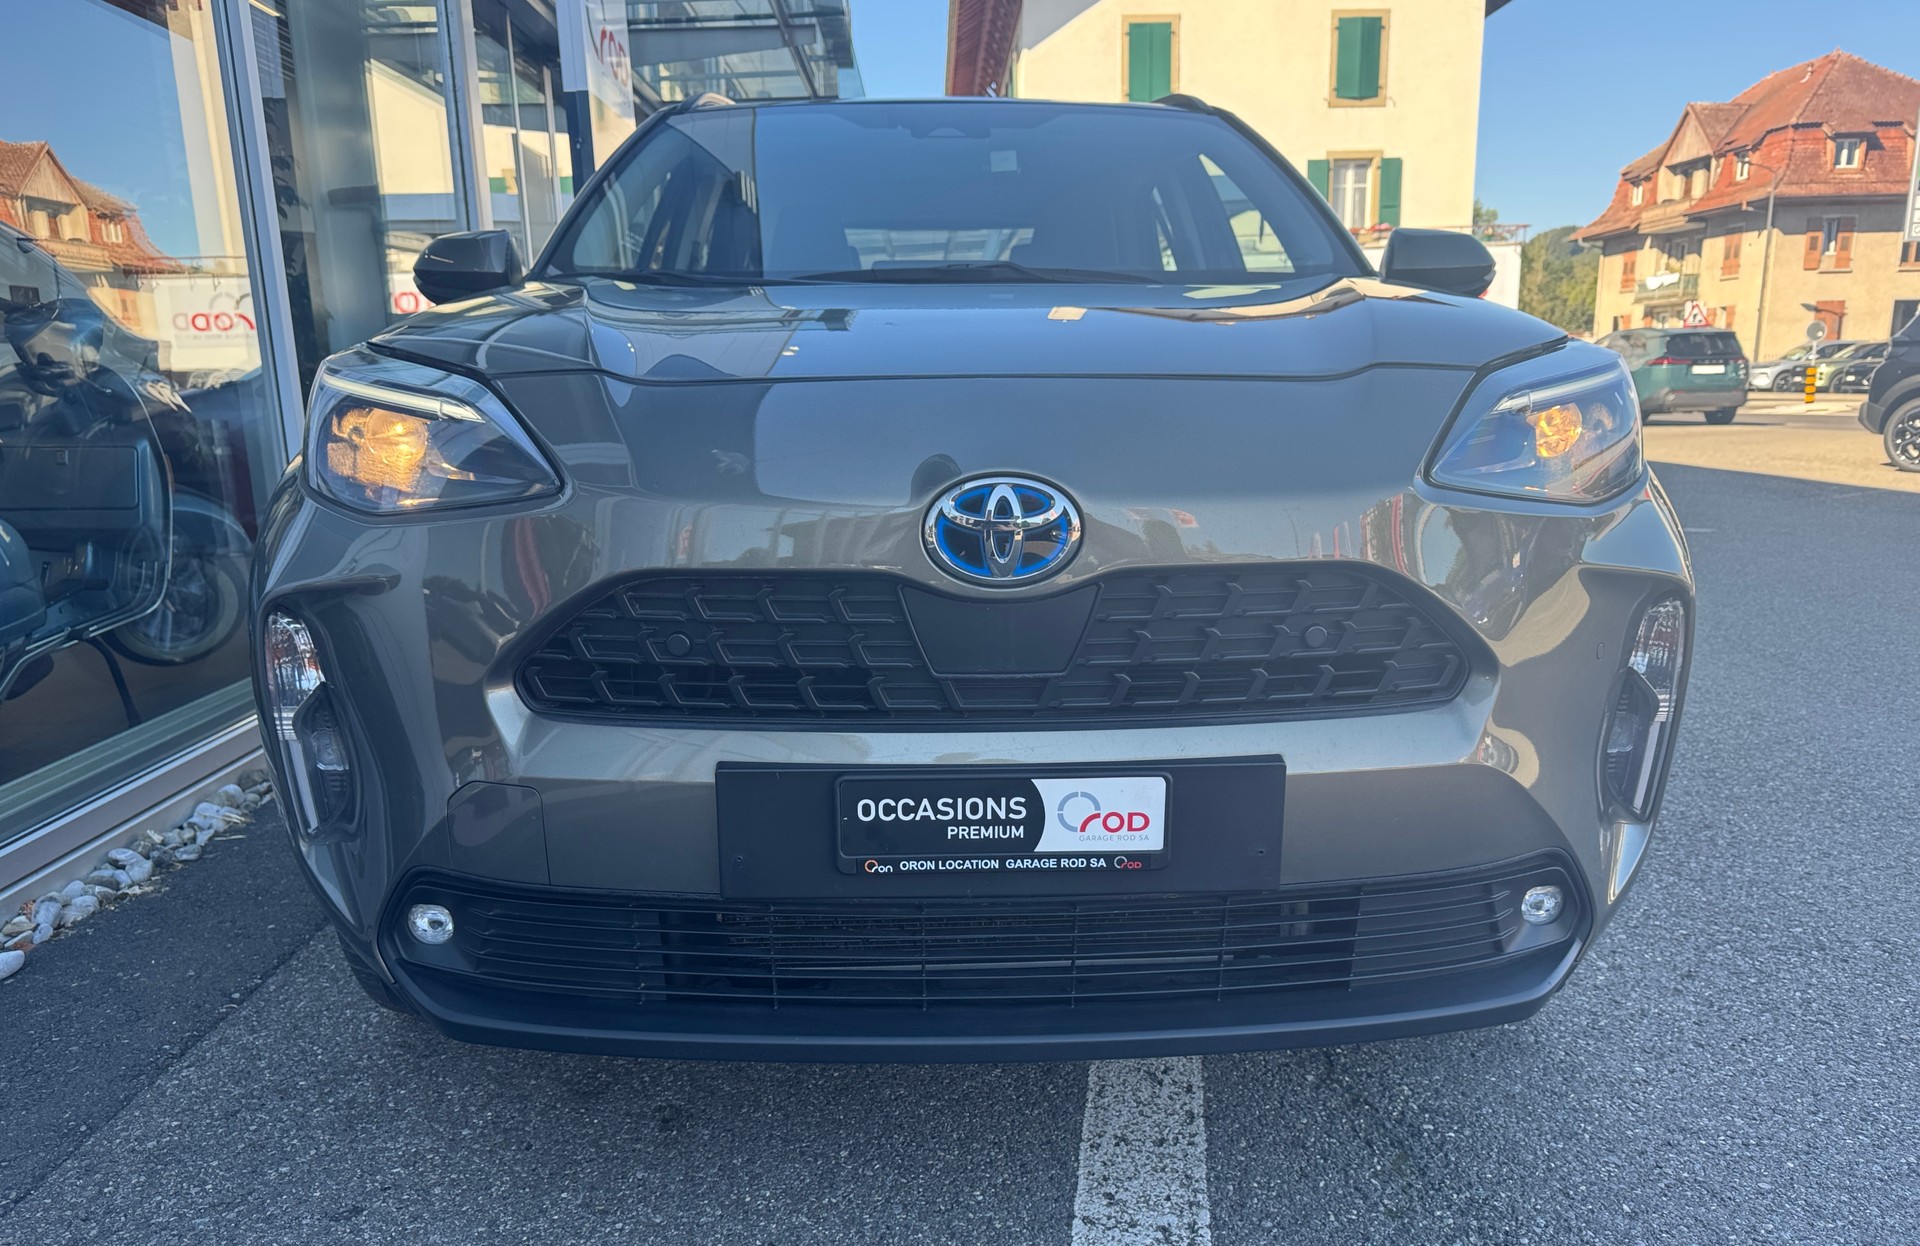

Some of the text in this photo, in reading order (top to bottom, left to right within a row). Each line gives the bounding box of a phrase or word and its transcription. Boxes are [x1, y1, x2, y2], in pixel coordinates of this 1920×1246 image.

[857, 797, 1027, 822] OCCASIONS
[947, 825, 1024, 839] PREMIUM
[1079, 834, 1114, 842] GARAGE
[900, 858, 1106, 871] ORON LOCATION GARAGE ROD SA
